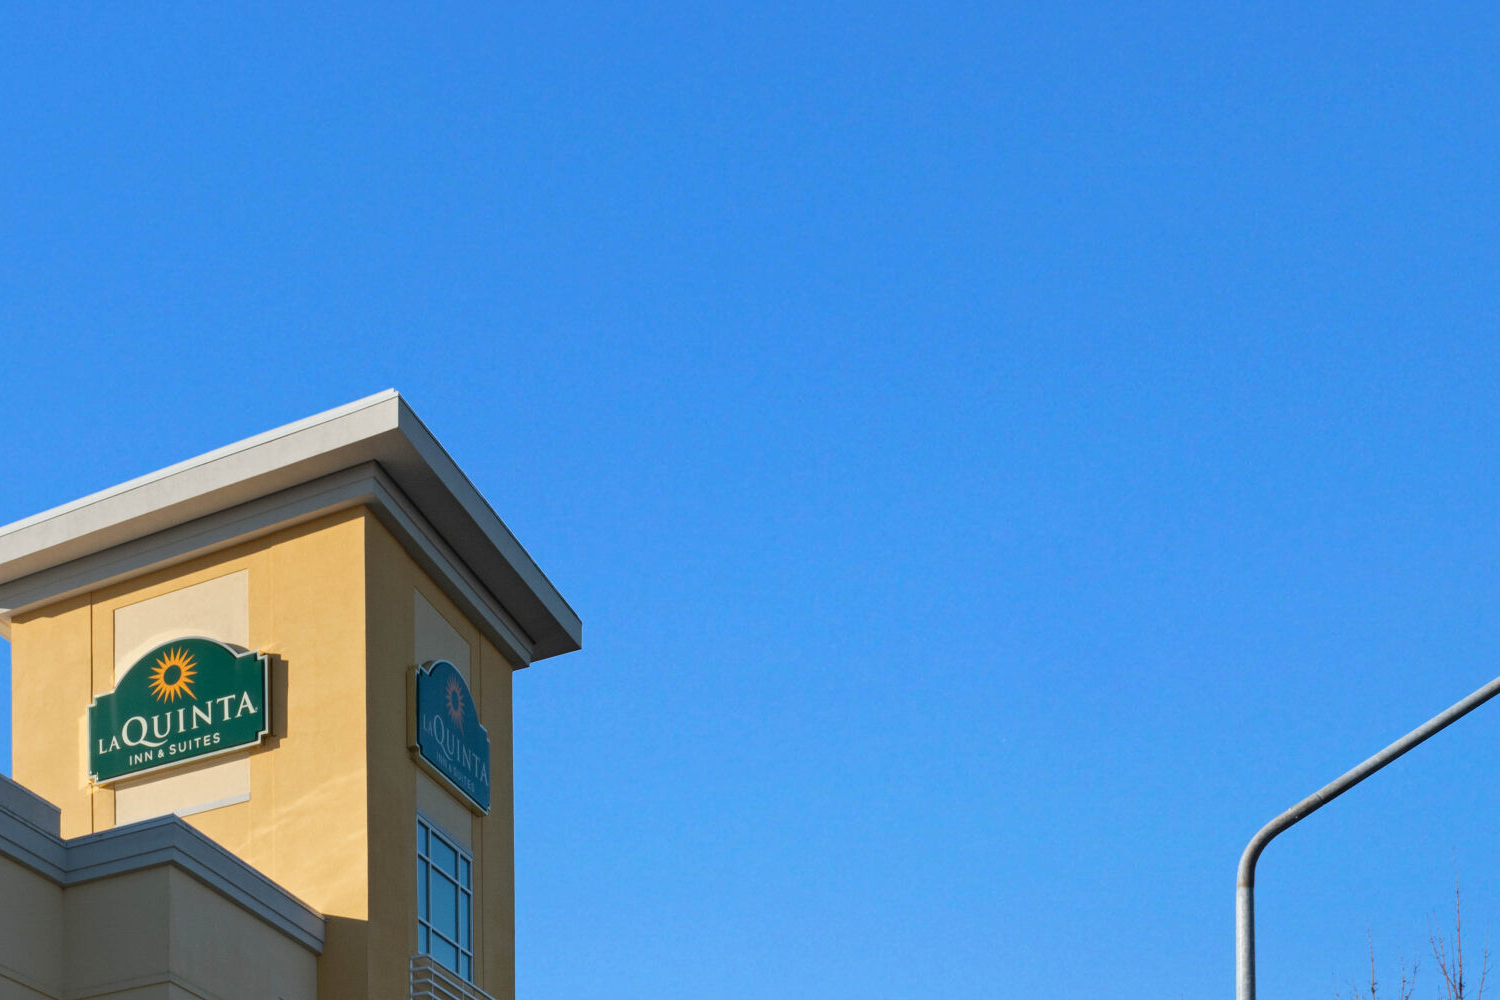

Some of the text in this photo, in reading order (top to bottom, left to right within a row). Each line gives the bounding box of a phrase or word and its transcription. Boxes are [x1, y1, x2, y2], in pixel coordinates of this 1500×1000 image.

[98, 690, 257, 755] LA QUINTA
[129, 732, 221, 766] INN & SUITES
[423, 713, 489, 786] LA QUINTA
